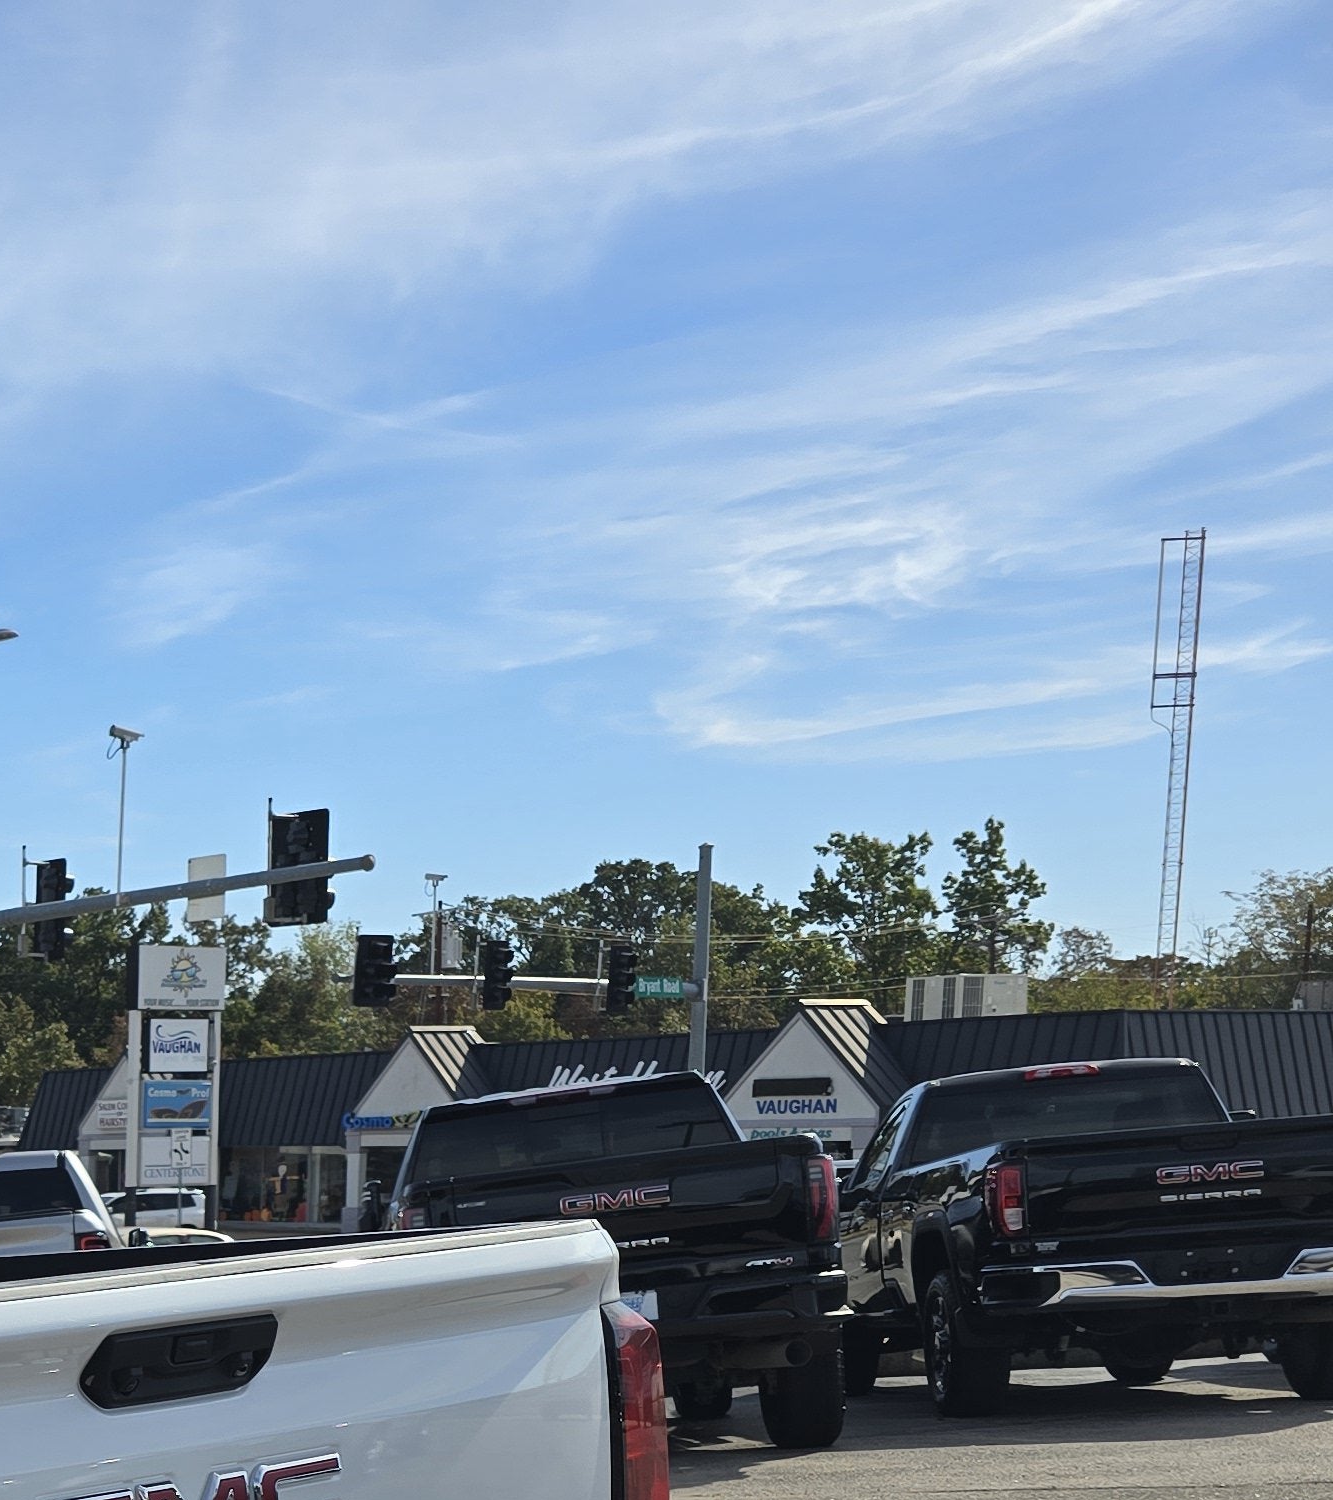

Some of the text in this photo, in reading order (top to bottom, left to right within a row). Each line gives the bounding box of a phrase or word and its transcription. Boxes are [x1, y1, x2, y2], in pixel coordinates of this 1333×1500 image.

[639, 978, 680, 995] Bryant Road
[152, 1040, 201, 1054] VAUGHAN
[148, 1087, 177, 1098] Cosmo
[756, 1098, 837, 1115] VAUGHAN
[342, 1113, 393, 1128] Cosmo
[1157, 1160, 1265, 1184] GMC
[560, 1184, 670, 1215] GMC
[1160, 1189, 1262, 1201] SIERRA
